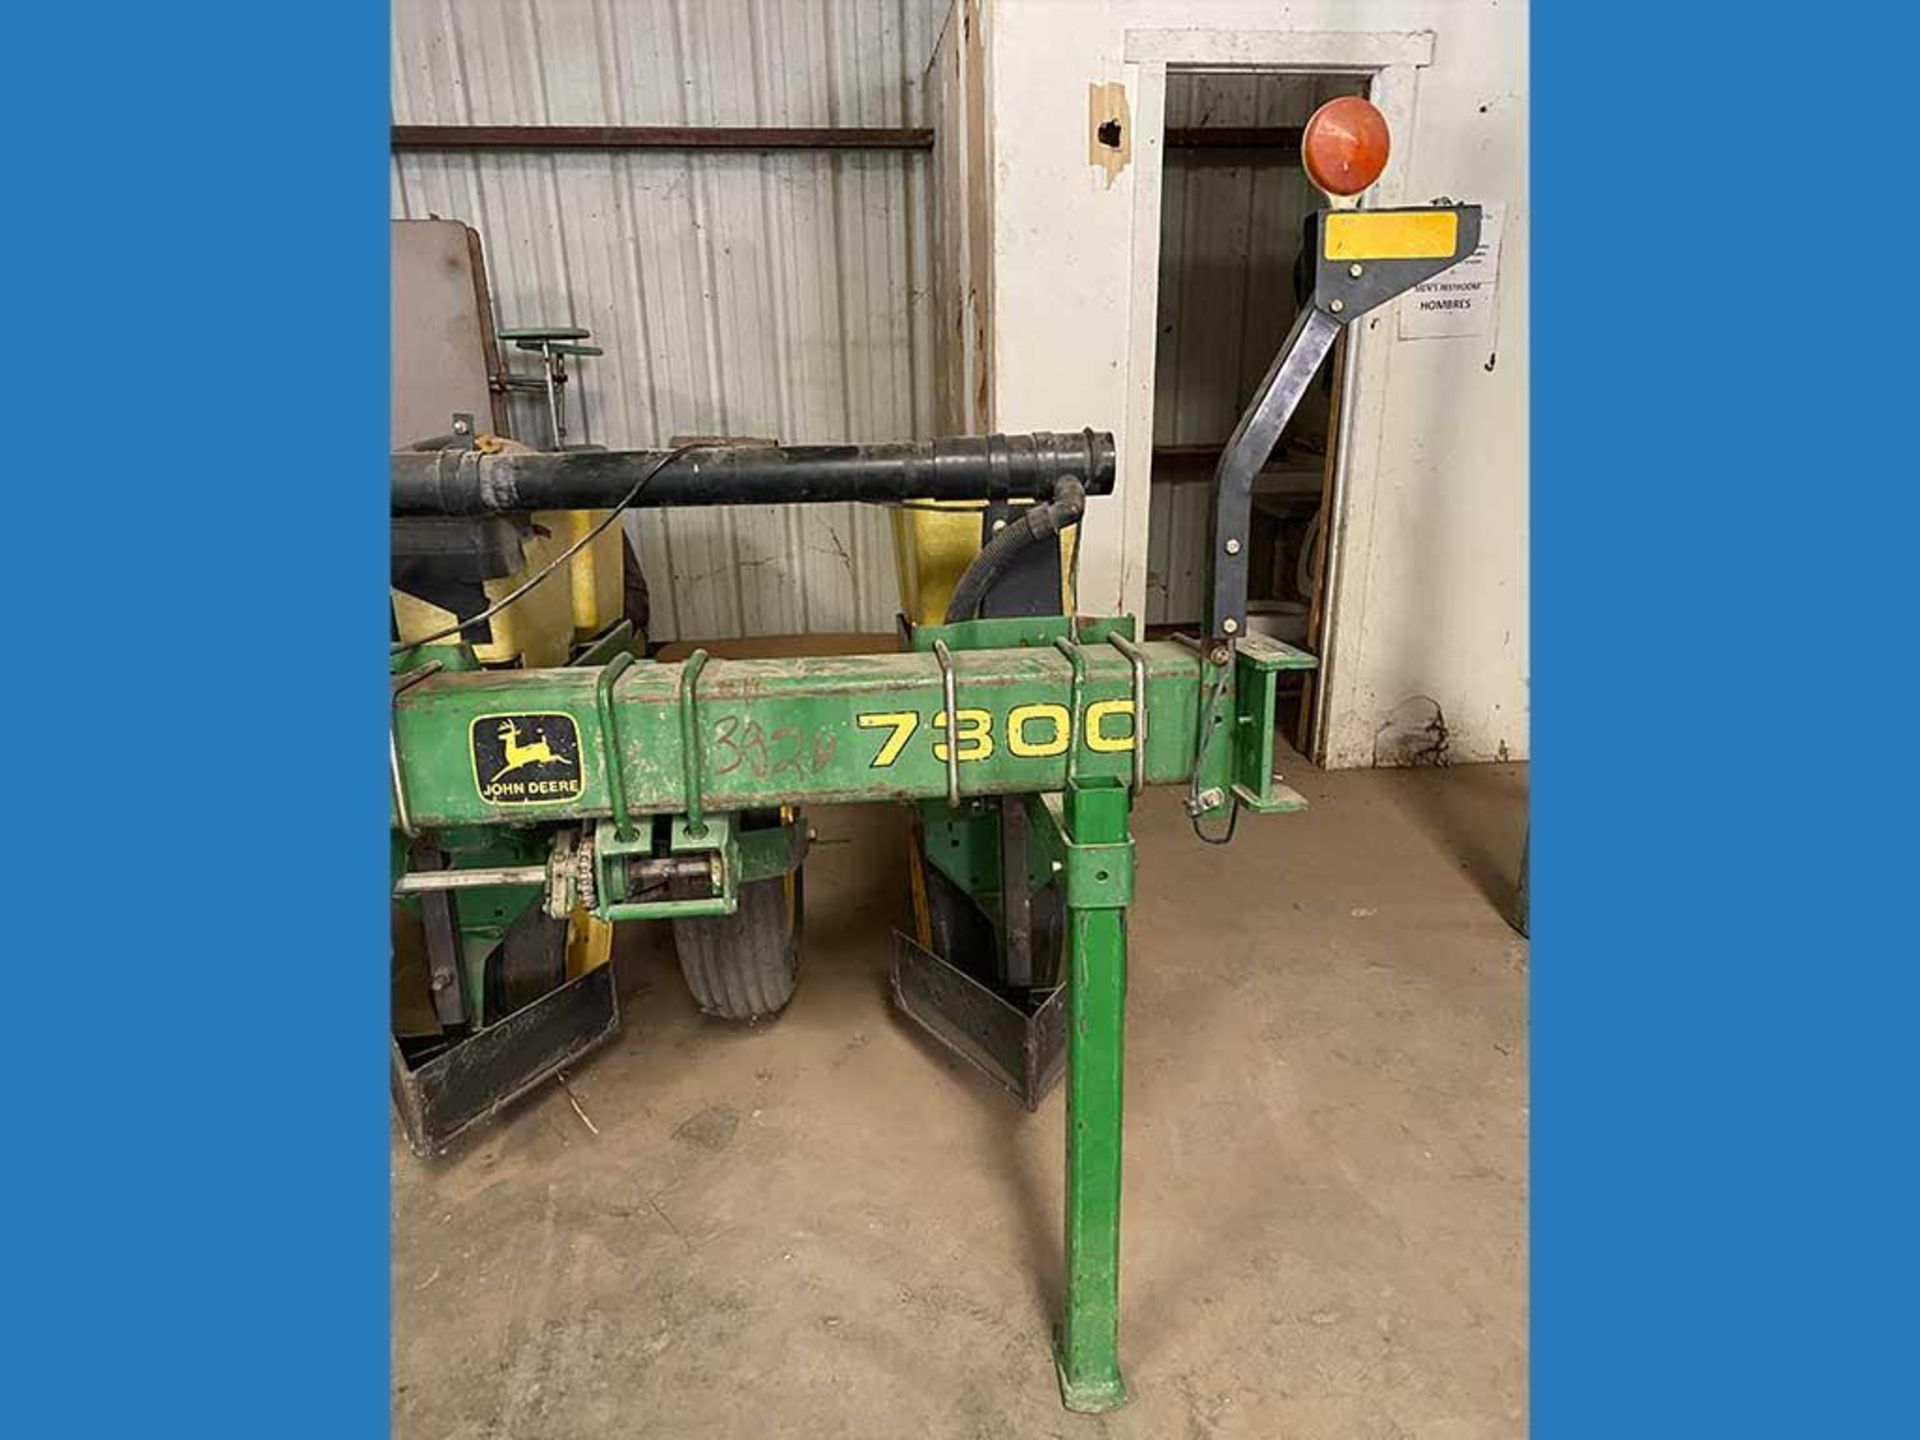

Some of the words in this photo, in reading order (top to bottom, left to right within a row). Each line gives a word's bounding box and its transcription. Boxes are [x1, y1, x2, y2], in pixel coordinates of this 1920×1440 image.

[1420, 299, 1471, 311] HOMBRES
[857, 699, 1150, 768] 7300
[483, 783, 524, 796] JOHN
[528, 779, 579, 794] DEERE
